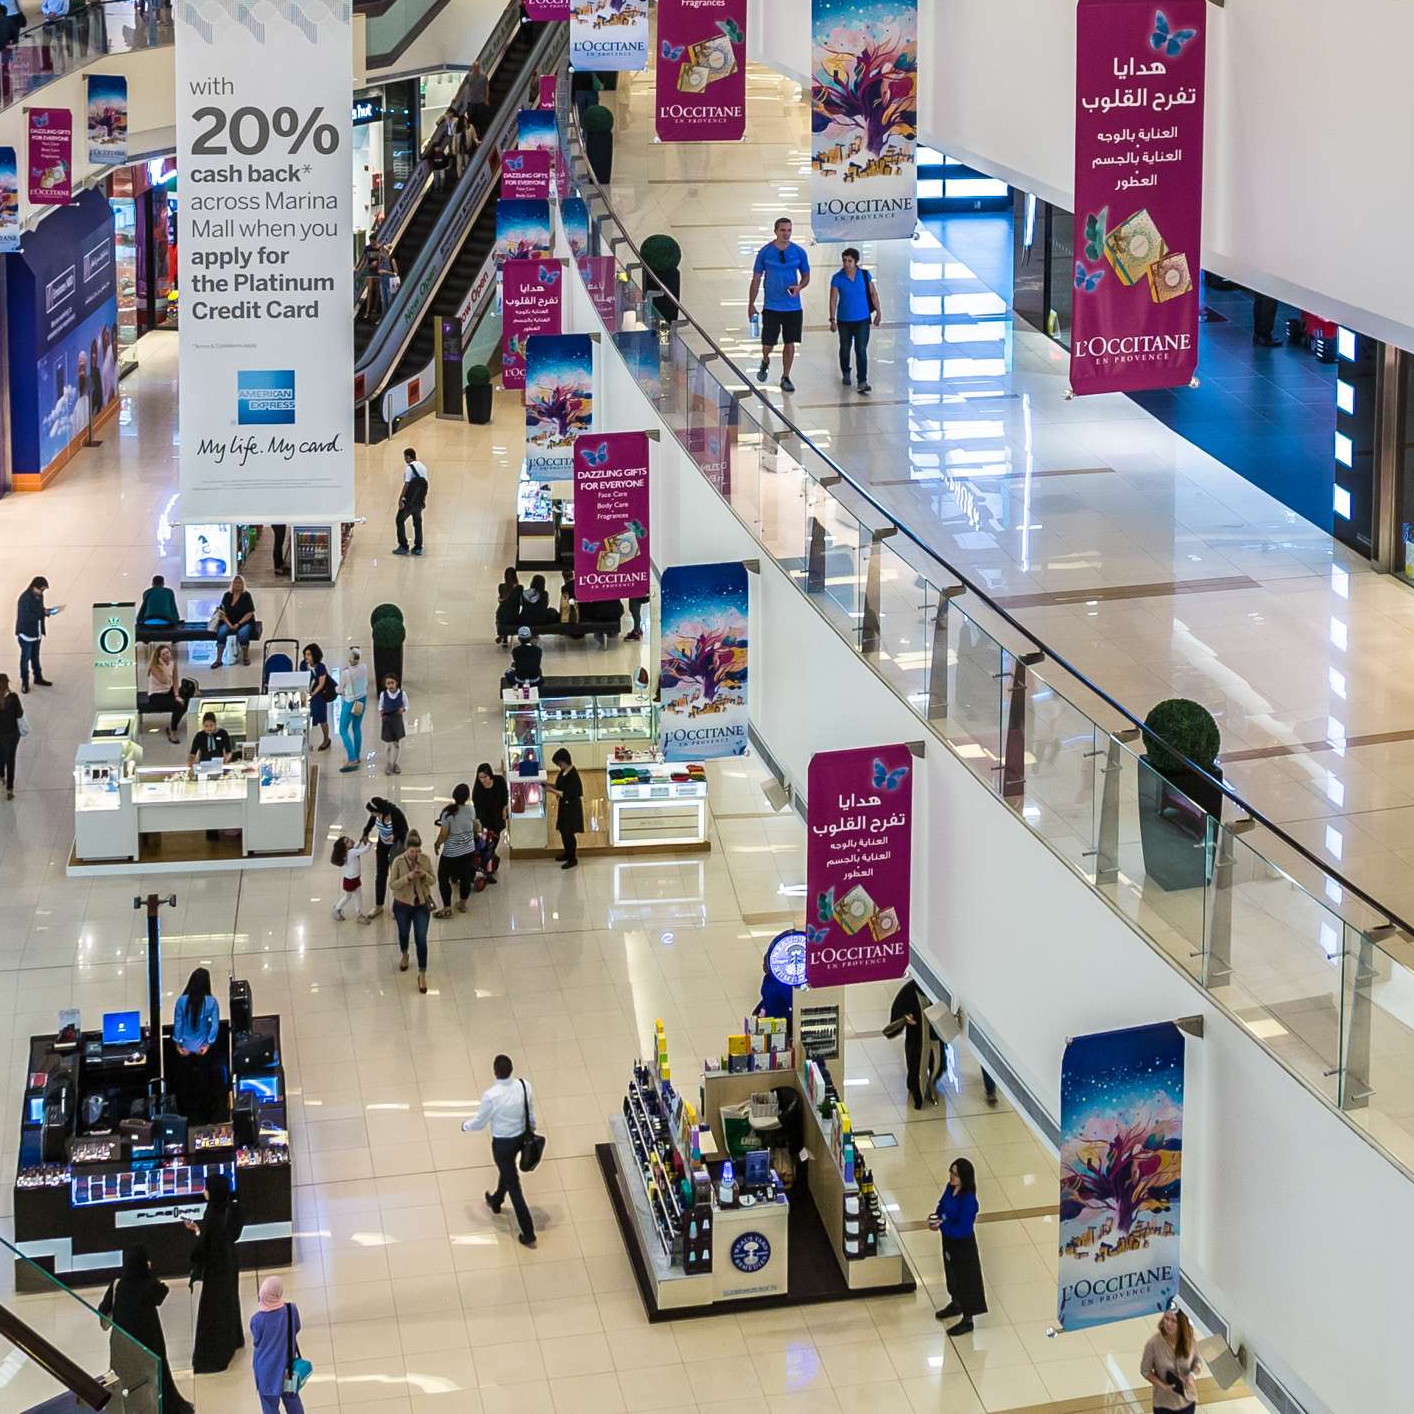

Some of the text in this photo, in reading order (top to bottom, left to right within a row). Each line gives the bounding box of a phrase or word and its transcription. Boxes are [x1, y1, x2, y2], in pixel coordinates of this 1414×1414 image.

[574, 41, 645, 54] L'OCCITANE
[1114, 58, 1166, 79] هدايا
[190, 77, 233, 95] with
[1082, 87, 1195, 113] تفرح القلوب
[661, 105, 741, 117] L'OCCITANE
[192, 107, 339, 155] 20%
[1098, 126, 1177, 143] العناية بالوجه
[1092, 150, 1181, 168] العناية بالجسم
[191, 165, 242, 182] cash
[1115, 174, 1157, 190] العطور
[191, 192, 337, 210] across Marina
[817, 198, 912, 215] L'OCCITANE
[849, 213, 894, 222] PROVENCE
[192, 219, 337, 241] Mall when you
[192, 246, 289, 269] apply for
[192, 274, 334, 292] the Platinum
[471, 272, 488, 302] Open
[192, 300, 318, 320] Credit Card
[1076, 334, 1190, 359] L'OCCITANE
[1115, 353, 1168, 363] PROVENCE
[238, 389, 291, 399] AMERICAN
[250, 401, 295, 410] EXPRESS
[197, 439, 226, 463] My
[268, 436, 295, 460] My
[578, 468, 647, 479] DAZZLING GIFTS
[581, 479, 644, 490] FOR EVERYONE
[579, 572, 647, 587] L'OCCITANE
[664, 726, 745, 744] L'OCCITANE
[839, 794, 881, 810] هدايا
[813, 813, 905, 837] تفرح القلوب
[811, 943, 904, 966] L'OCCITANE
[1060, 1266, 1174, 1308] L'OCCITANE
[1097, 1284, 1150, 1303] PROVENCE
